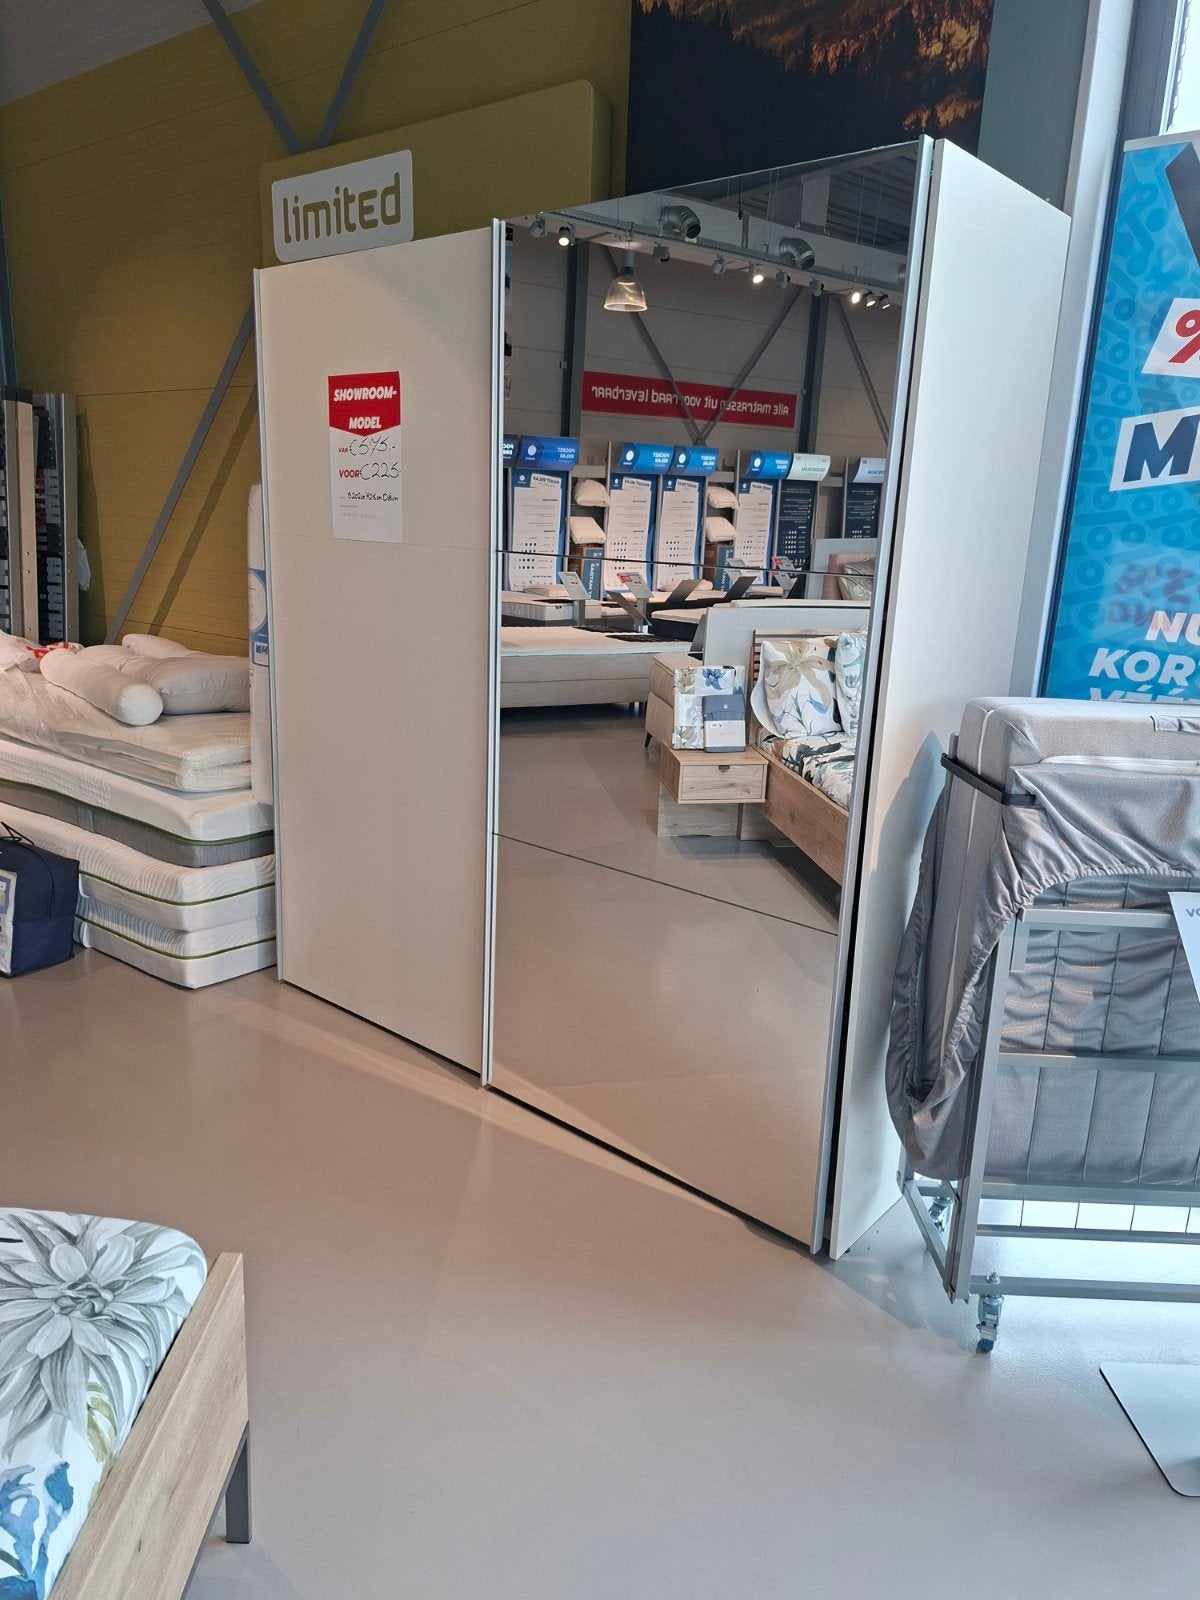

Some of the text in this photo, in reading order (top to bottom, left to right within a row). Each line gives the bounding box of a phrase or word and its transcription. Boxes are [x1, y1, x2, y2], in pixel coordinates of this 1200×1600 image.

[282, 172, 401, 244] limited
[334, 386, 397, 402] SHOWROOM-
[349, 416, 381, 430] MODEL
[339, 469, 360, 478] VOOR
[1088, 647, 1200, 687] KOR
